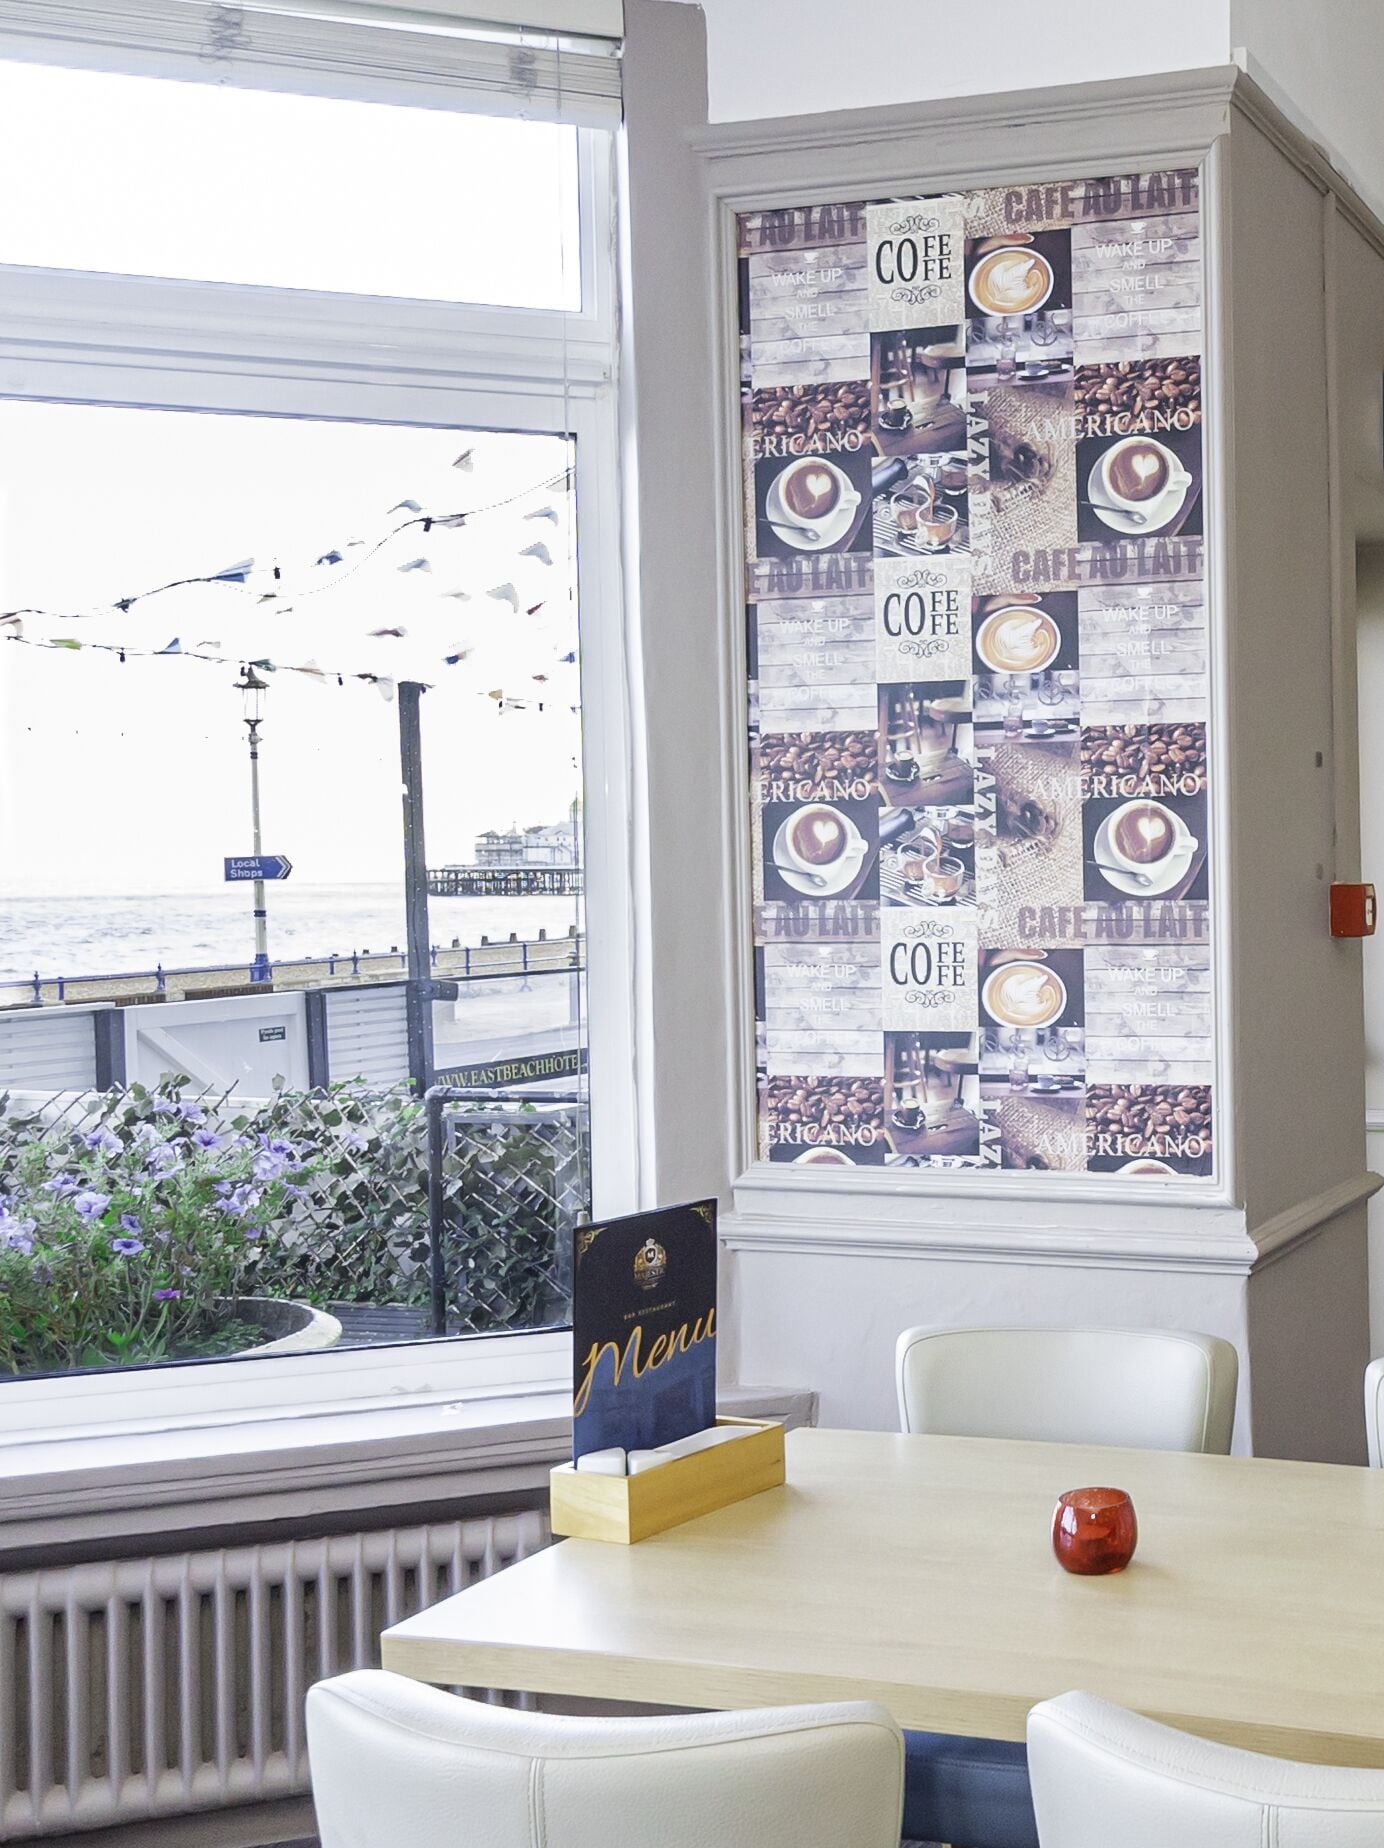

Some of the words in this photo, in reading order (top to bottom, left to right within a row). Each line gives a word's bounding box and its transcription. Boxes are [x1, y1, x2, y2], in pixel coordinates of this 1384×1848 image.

[1004, 187, 1075, 224] CAFE
[1082, 179, 1122, 216] AU
[1131, 169, 1198, 210] LAIT
[759, 210, 796, 246] AU
[804, 203, 867, 242] LAIT
[1095, 241, 1142, 258] WAKE
[1149, 239, 1173, 254] UP
[1121, 259, 1146, 270] AND
[771, 270, 816, 287] WAKE
[820, 267, 842, 282] UP
[1109, 274, 1164, 292] SMELL
[1124, 293, 1145, 305] THE
[785, 302, 835, 320] SMELL
[1026, 407, 1195, 442] AMERICANO
[966, 391, 991, 481] LAZY
[1011, 548, 1082, 584] CAFE
[1089, 543, 1128, 579] AU
[1137, 539, 1201, 577] LAIT
[767, 557, 804, 592] AU
[811, 554, 873, 590] LAIT
[1102, 606, 1149, 622] WAKE
[1154, 604, 1178, 620] UP
[780, 619, 823, 634] WAKE
[827, 617, 849, 633] UP
[1115, 640, 1171, 657] SMELL
[792, 652, 843, 668] SMELL
[973, 746, 997, 836] LAZY
[1030, 772, 1201, 800] AMERICANO
[231, 858, 260, 868] Local
[230, 868, 263, 878] Shops
[774, 904, 810, 937] AU
[818, 903, 879, 936] LAIT
[1018, 905, 1088, 939] CAFE
[1095, 905, 1134, 938] AU
[1143, 903, 1208, 938] LAIT
[787, 964, 830, 978] WAKE
[835, 964, 857, 978] UP
[1108, 967, 1156, 982] WAKE
[1161, 967, 1185, 982] UP
[799, 996, 850, 1012] SMELL
[1122, 1002, 1177, 1017] SMELL
[434, 1053, 588, 1087] WW.EASTBEACHHOTE
[979, 1099, 1002, 1168] LAZ
[1035, 1132, 1205, 1159] AMERICANO
[573, 1307, 717, 1418] Menu
